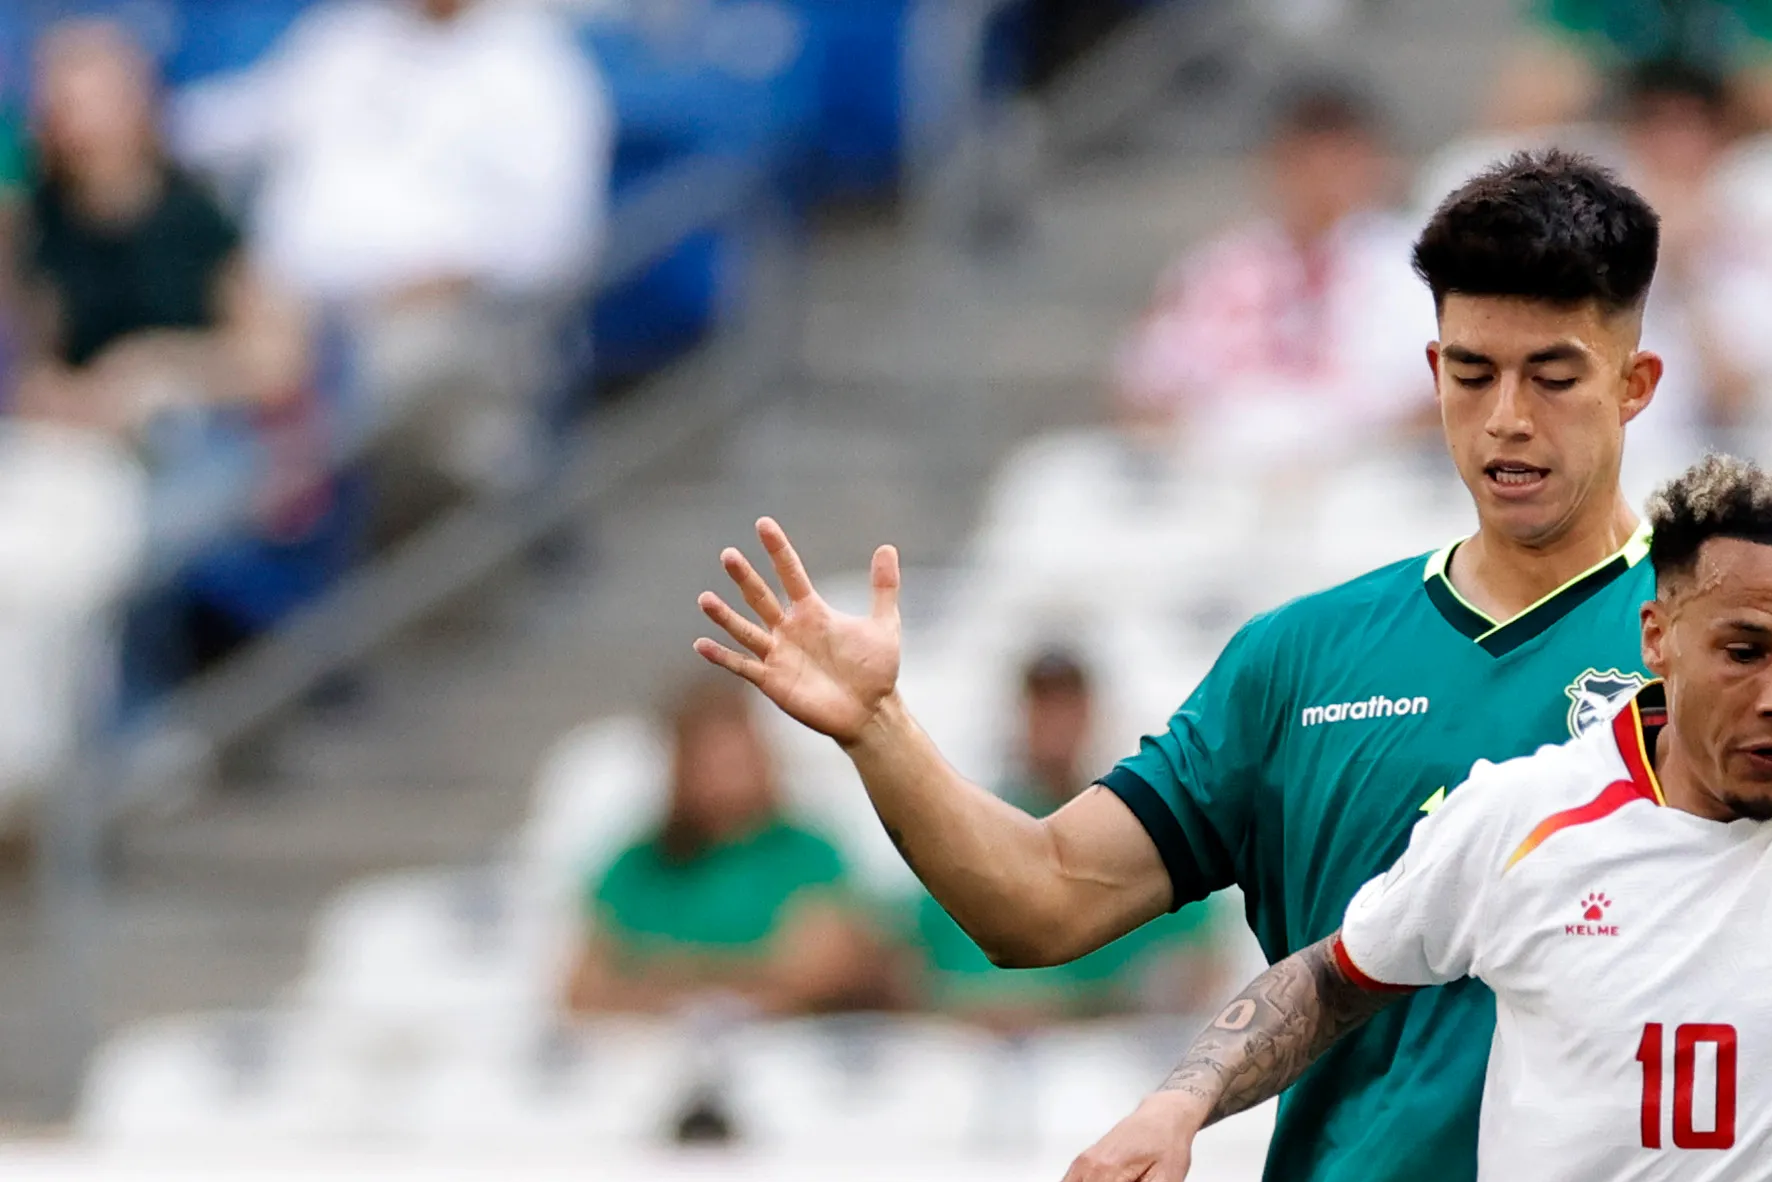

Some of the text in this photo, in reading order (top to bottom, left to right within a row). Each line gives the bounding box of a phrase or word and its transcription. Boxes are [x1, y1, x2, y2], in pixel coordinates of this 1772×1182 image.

[1301, 694, 1429, 728] marathon
[1564, 924, 1620, 937] KELME
[1635, 1022, 1738, 1151] 10
